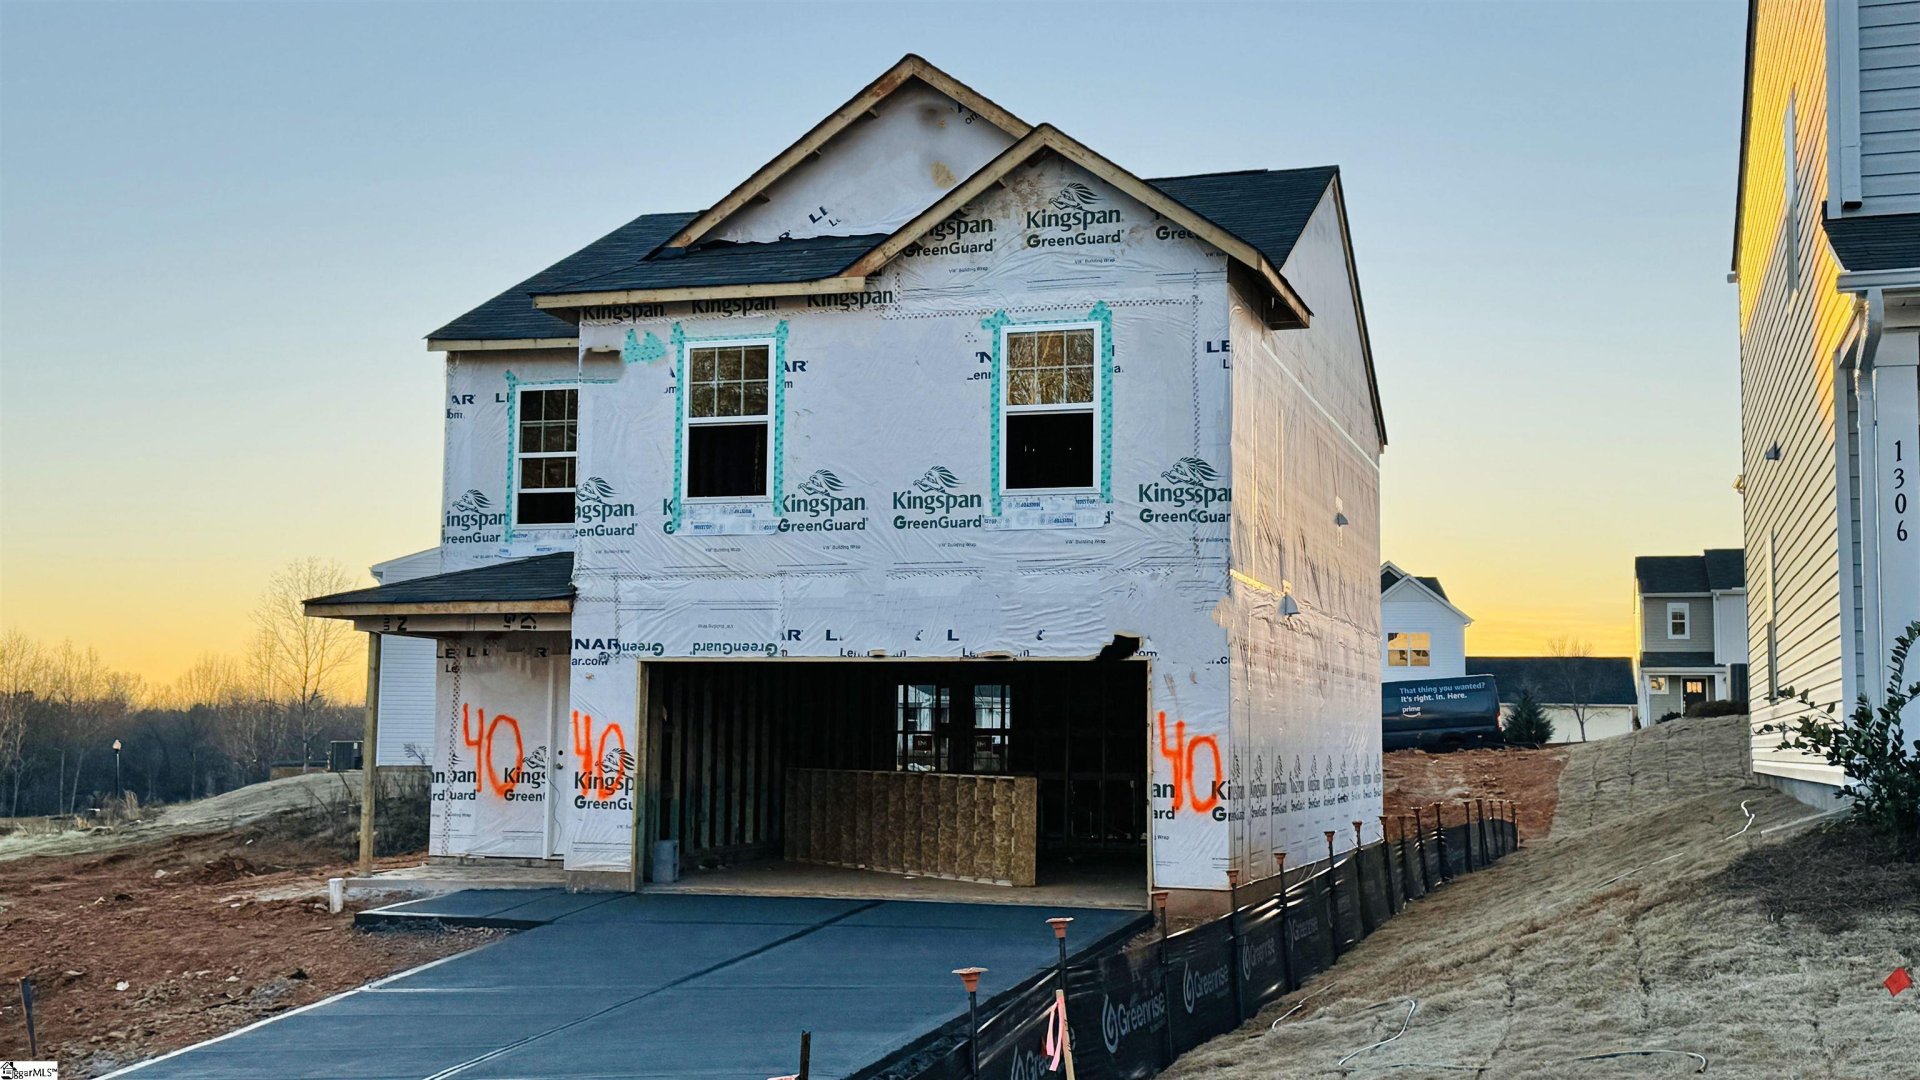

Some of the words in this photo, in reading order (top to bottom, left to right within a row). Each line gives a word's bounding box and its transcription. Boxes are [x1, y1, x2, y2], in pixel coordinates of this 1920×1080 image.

[1027, 209, 1121, 232] Kingspan
[904, 239, 993, 258] GreenGuard
[1027, 230, 1121, 248] GreenGuard
[583, 303, 664, 322] Kingspan
[691, 297, 776, 317] Kingspan
[807, 290, 894, 310] Kingspan
[893, 490, 982, 514] Kingspan
[778, 518, 866, 533] GreenGuard
[893, 514, 982, 530] GreenGuard
[693, 642, 778, 657] GreenGuard
[1399, 687, 1417, 695] That
[1418, 685, 1437, 694] thing
[1439, 685, 1452, 693] you
[1454, 682, 1485, 691] wanted?
[1400, 695, 1413, 703] It's
[1413, 694, 1434, 703] right.
[1447, 692, 1468, 700] Here.
[1402, 706, 1421, 714] prime
[463, 702, 524, 797] 40
[572, 709, 627, 801] 40
[1158, 710, 1223, 813] 40
[1194, 962, 1229, 998] Greenrise
[1117, 990, 1166, 1036] Greenrise
